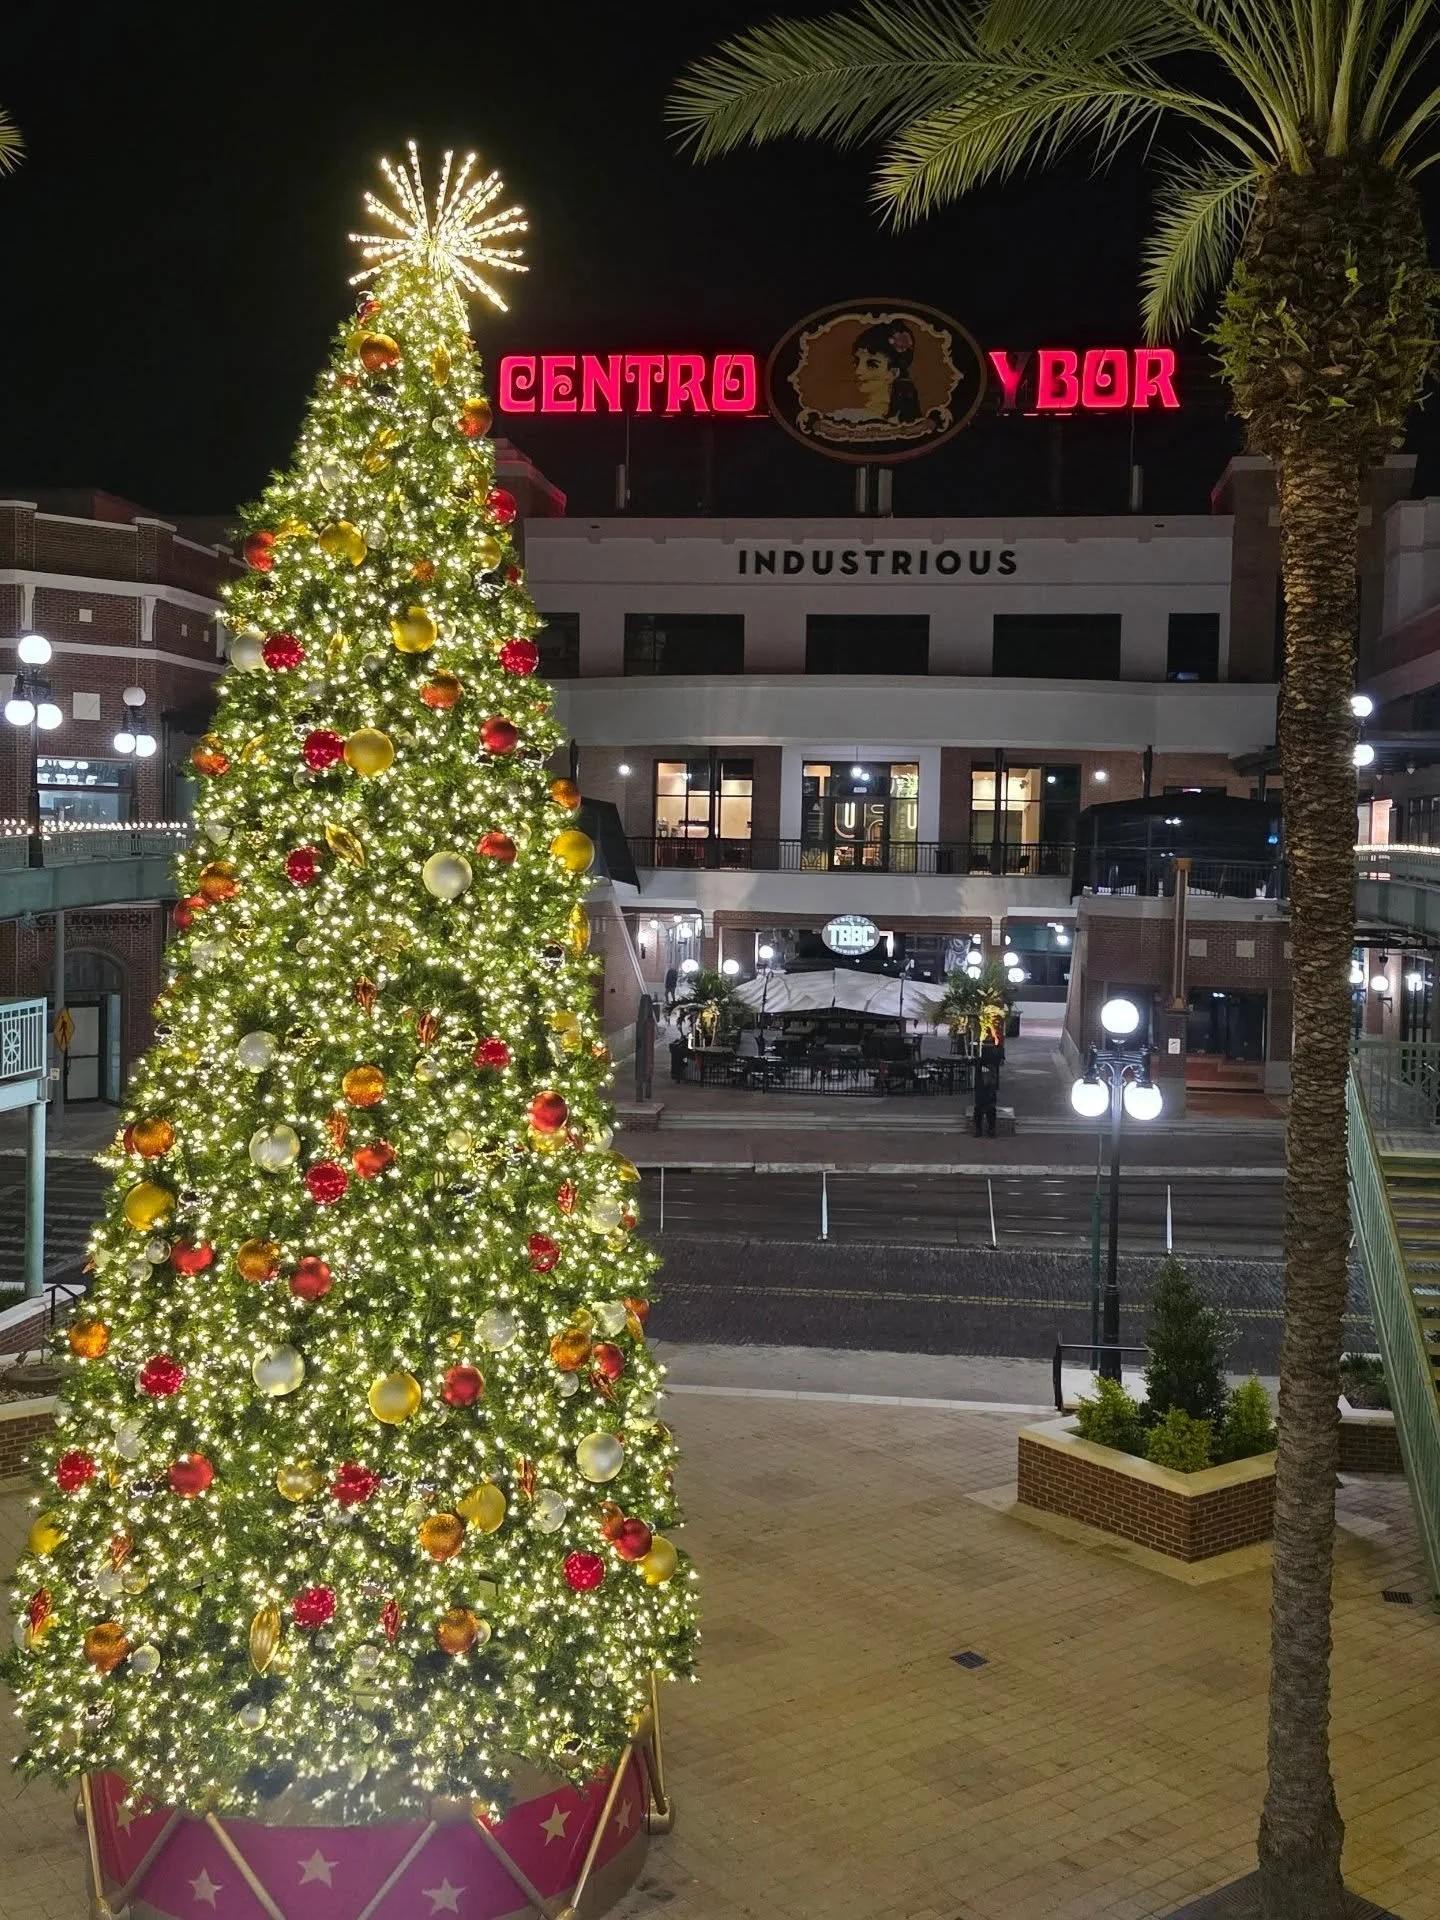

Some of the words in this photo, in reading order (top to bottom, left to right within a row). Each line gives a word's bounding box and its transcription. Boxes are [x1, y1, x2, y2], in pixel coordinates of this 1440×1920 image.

[499, 354, 757, 414] CENTRO
[989, 347, 1180, 409] YBOR
[738, 549, 1017, 576] INDUSTRIOUS
[827, 925, 875, 947] TBBC
